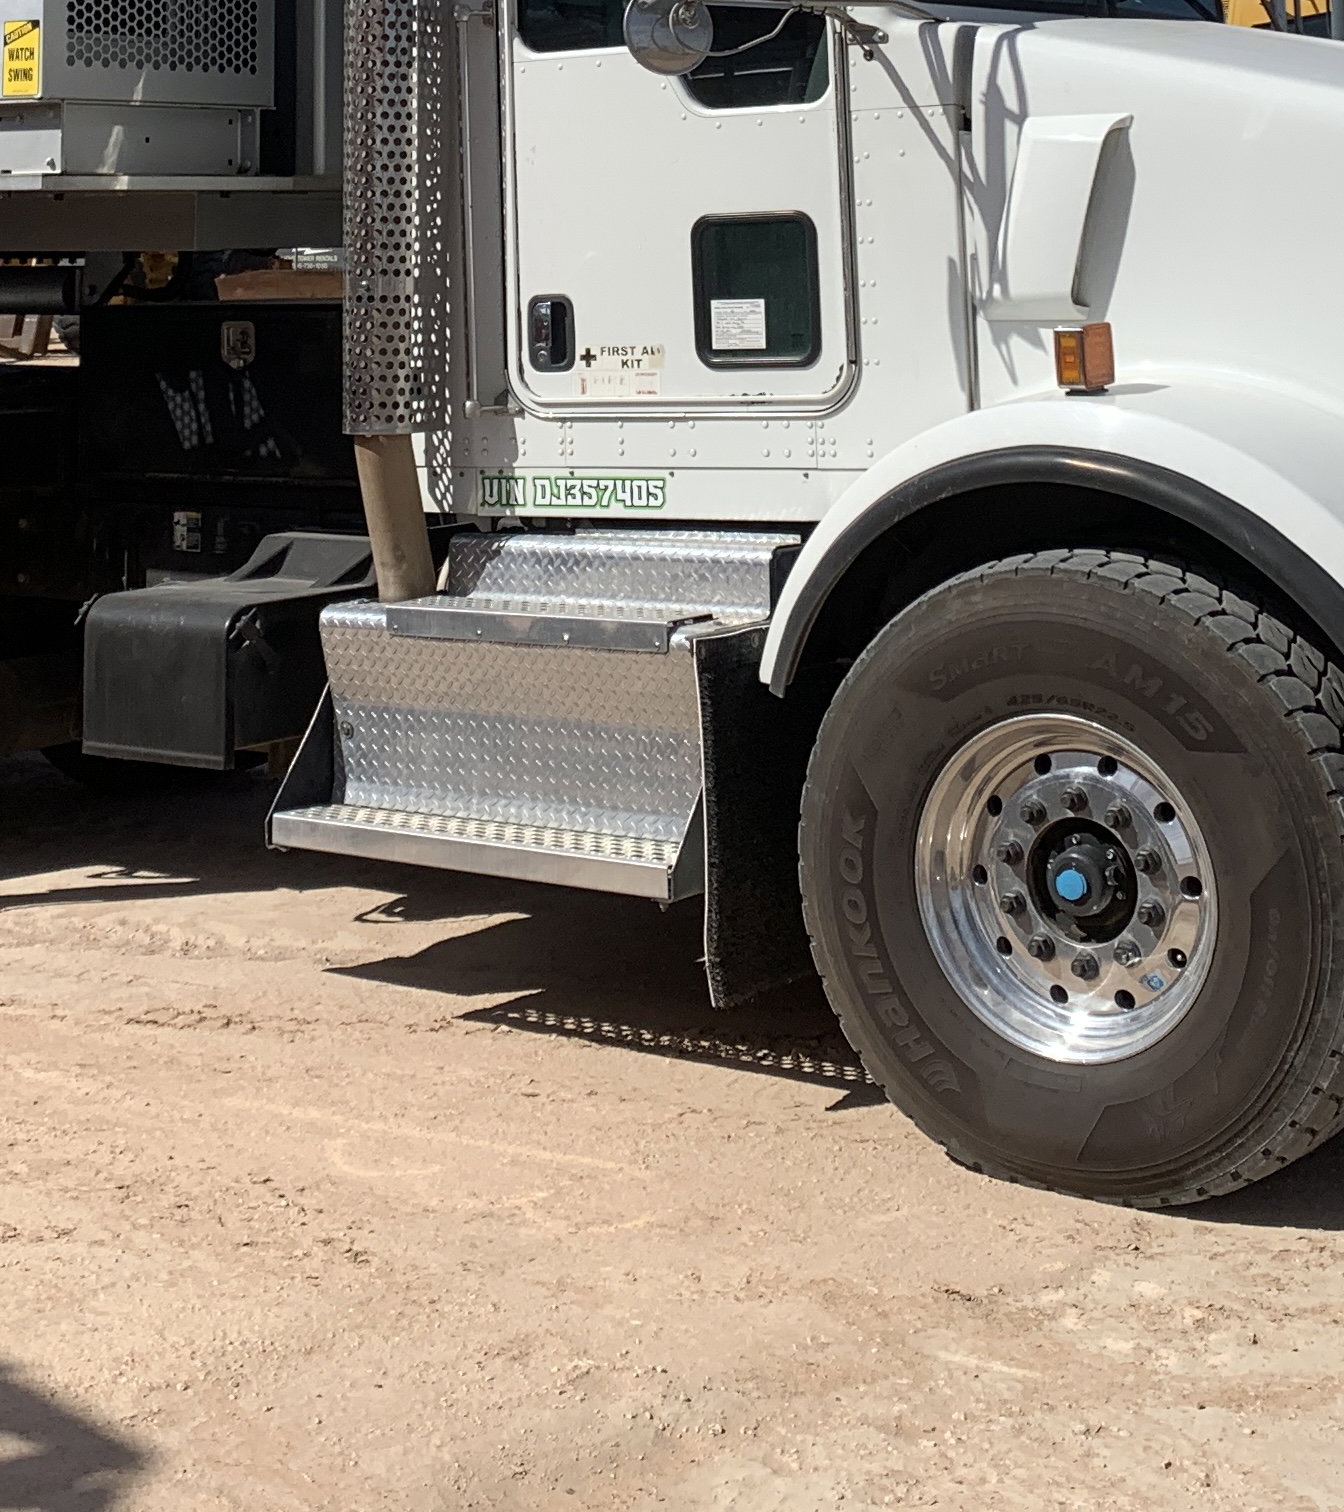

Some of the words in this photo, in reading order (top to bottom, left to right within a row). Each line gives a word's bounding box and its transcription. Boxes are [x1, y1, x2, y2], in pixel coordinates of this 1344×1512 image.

[7, 47, 35, 62] WATCH
[7, 67, 34, 83] SWING
[600, 345, 637, 357] FIRST
[621, 358, 643, 369] KIT
[482, 476, 527, 507] VIN
